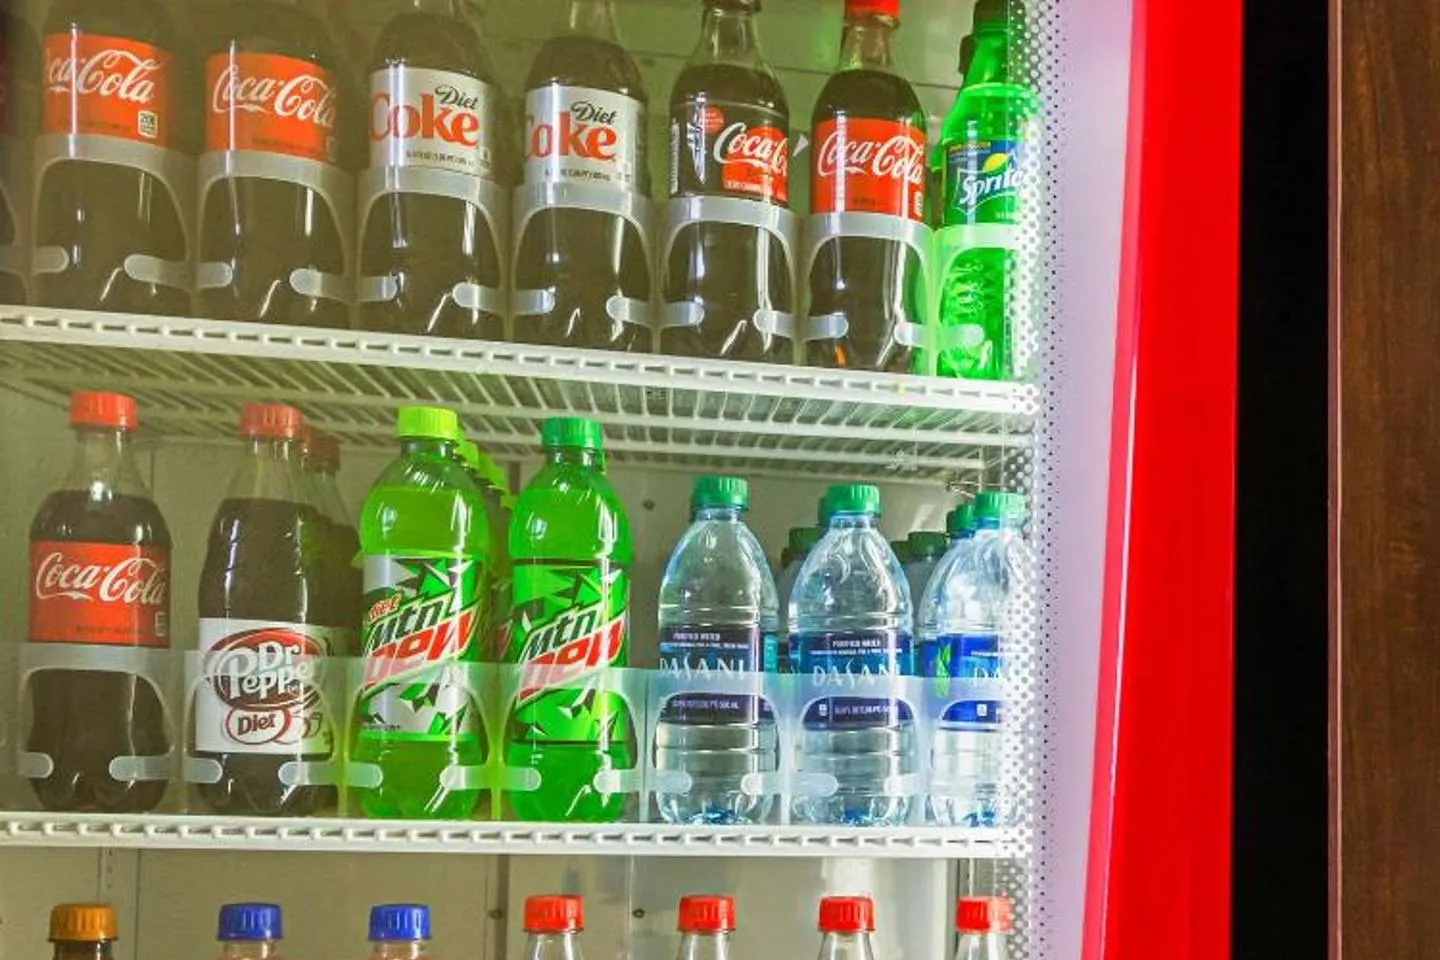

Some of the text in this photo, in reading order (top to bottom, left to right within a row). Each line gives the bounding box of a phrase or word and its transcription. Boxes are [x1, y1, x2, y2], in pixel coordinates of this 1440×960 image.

[434, 85, 478, 110] Diet
[571, 100, 617, 125] Diet
[36, 552, 166, 606] Coca-Cola
[256, 640, 301, 669] Dr
[659, 651, 745, 681] DASANI
[237, 714, 277, 737] Diet
